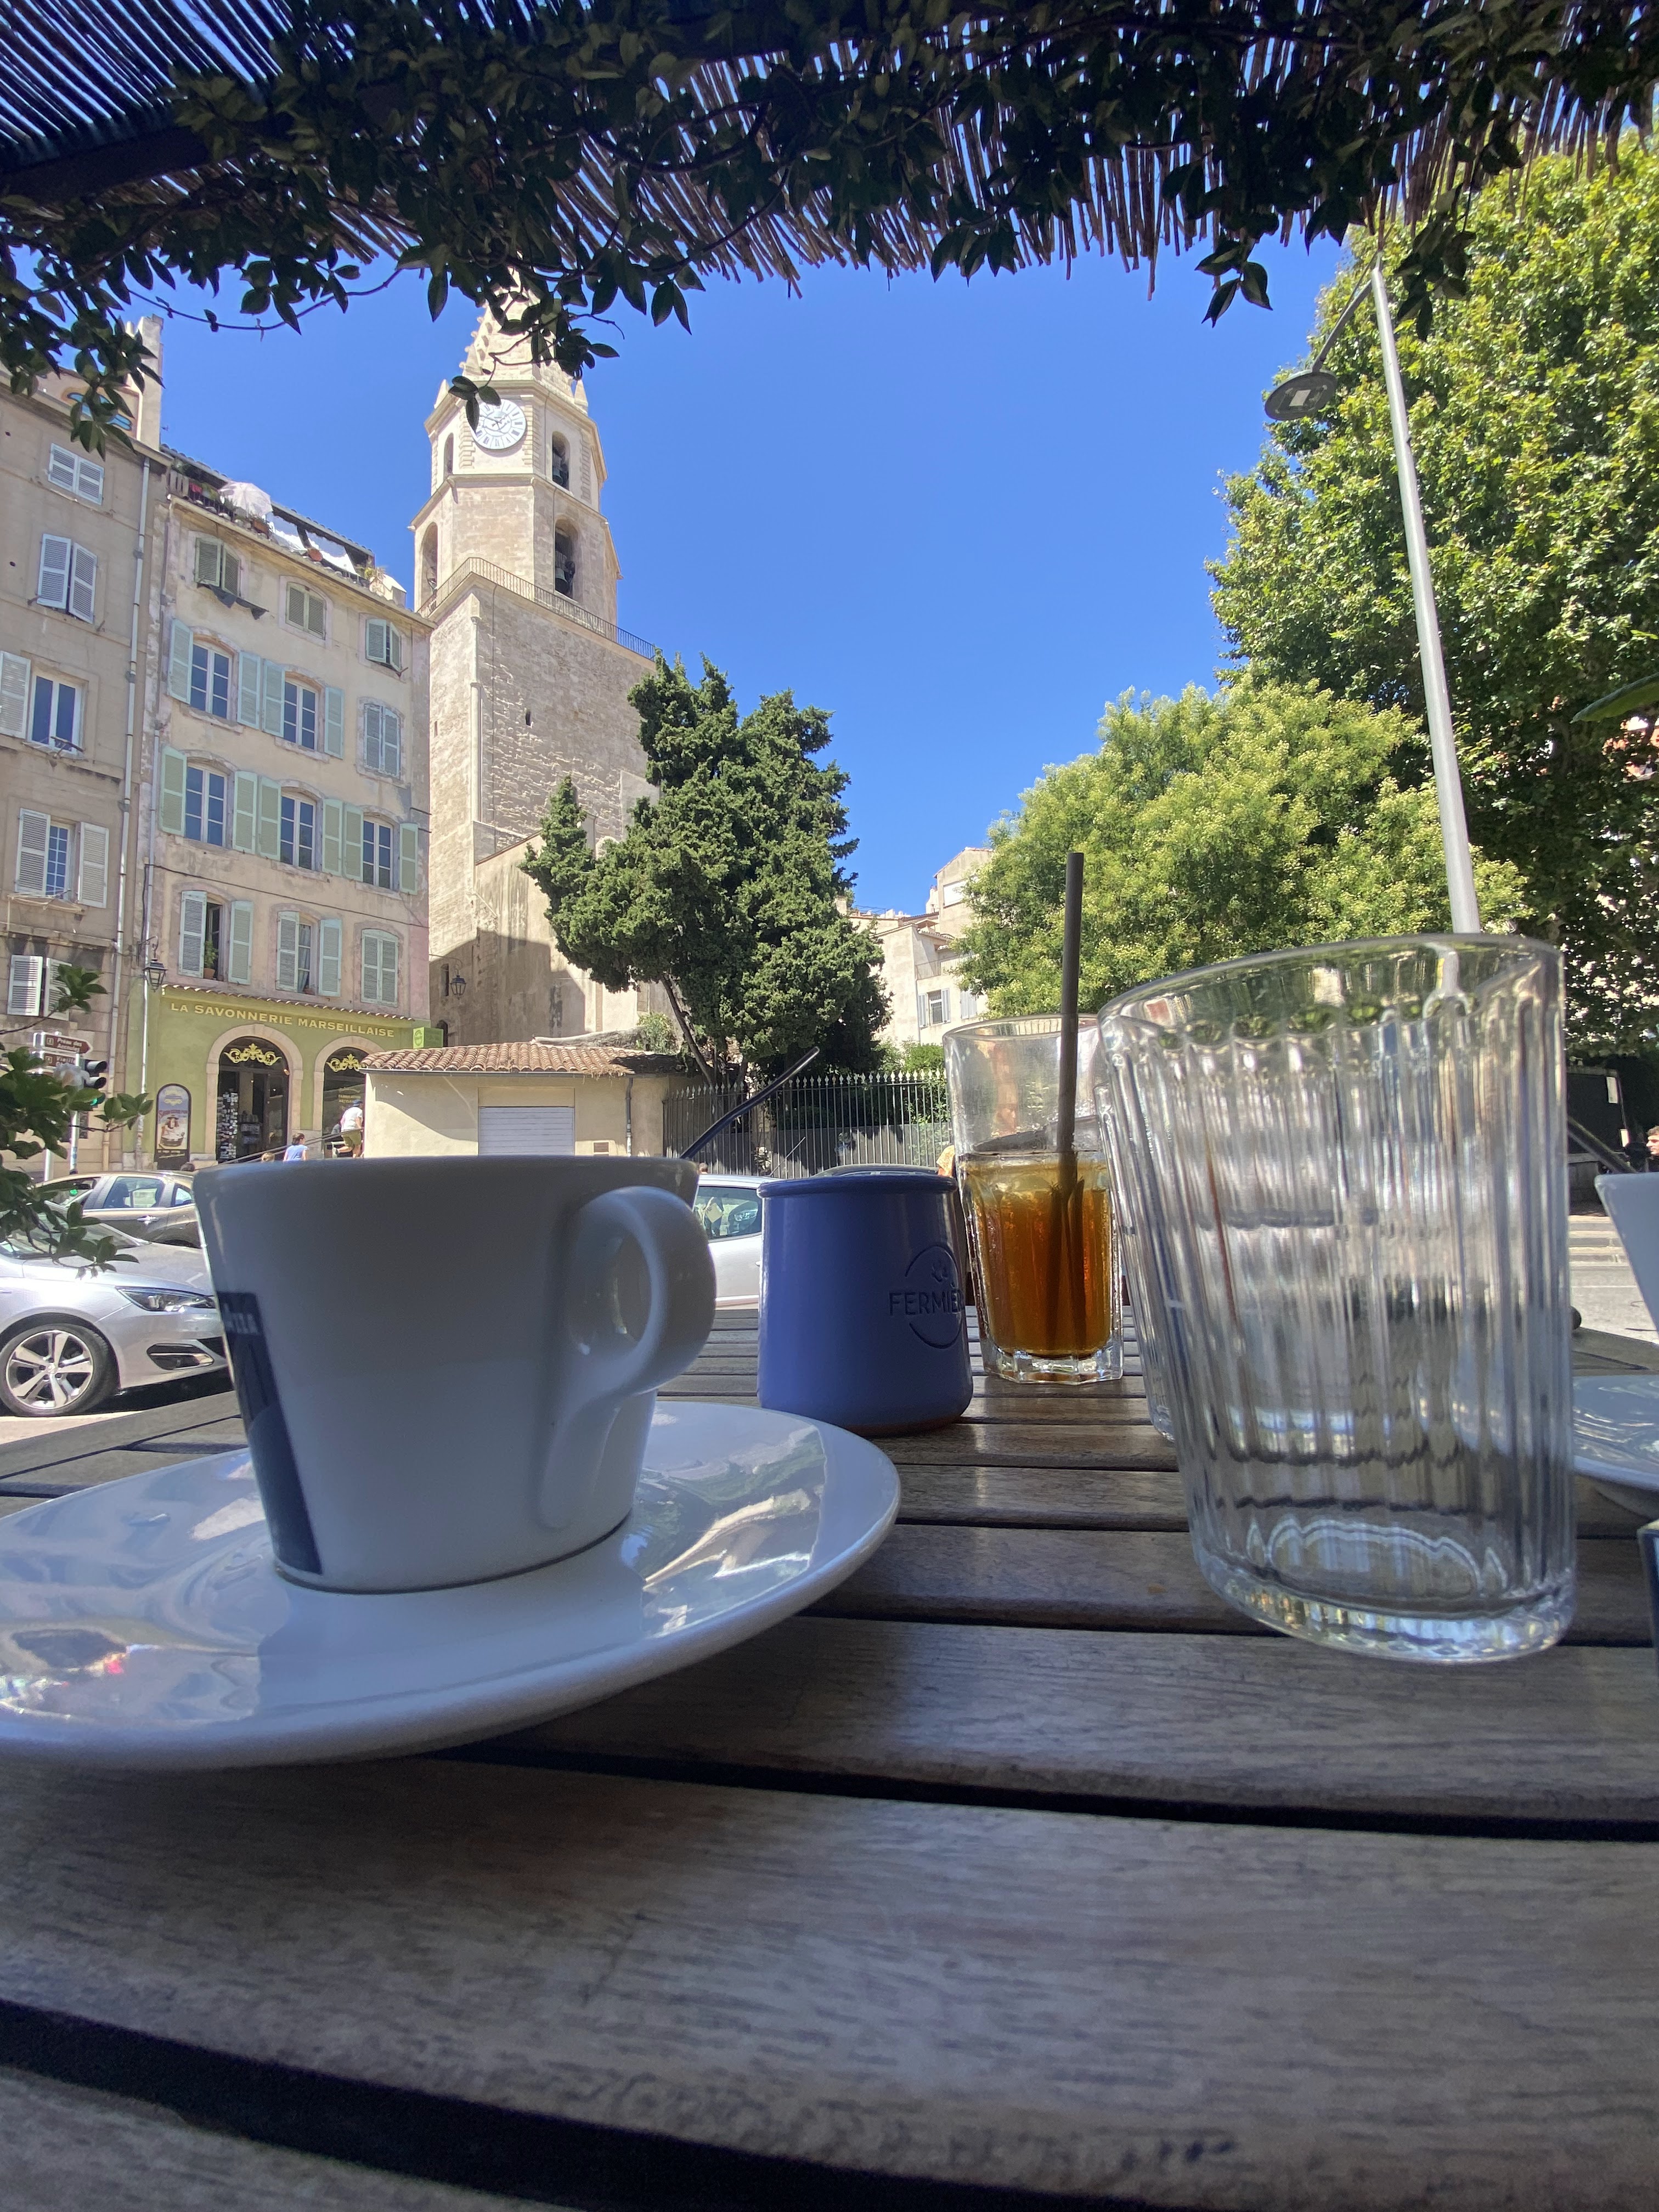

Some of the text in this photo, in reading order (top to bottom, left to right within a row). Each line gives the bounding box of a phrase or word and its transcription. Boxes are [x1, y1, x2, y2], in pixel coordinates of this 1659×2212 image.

[171, 1003, 394, 1037] LA SAVONNERIE MARSEILLAISE
